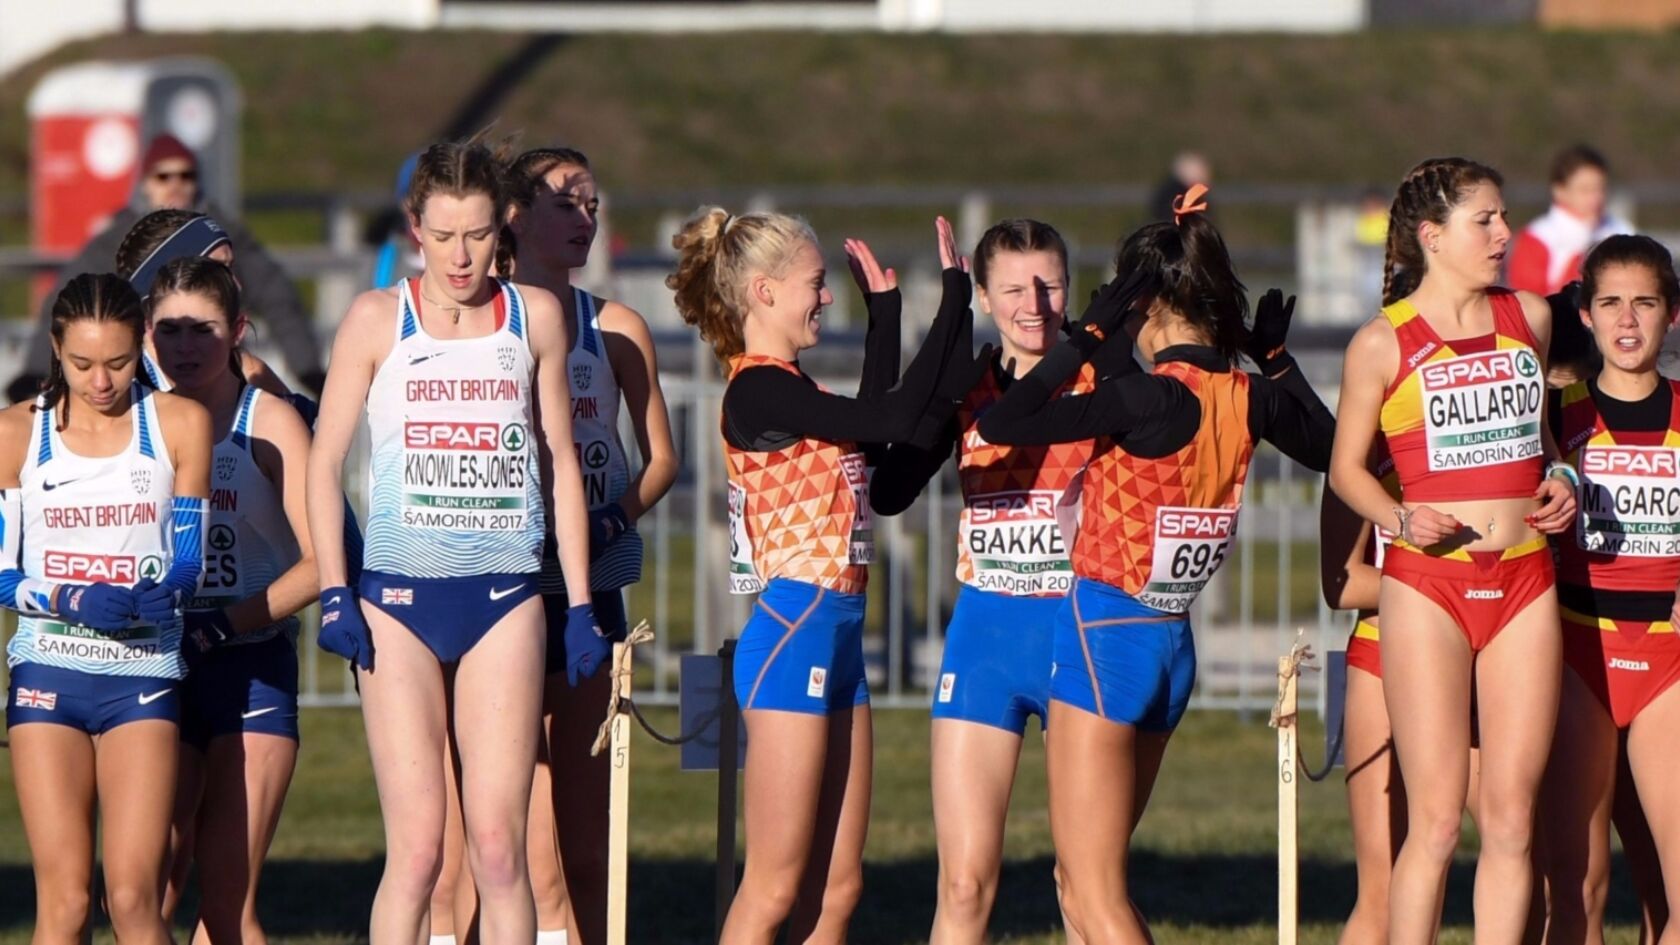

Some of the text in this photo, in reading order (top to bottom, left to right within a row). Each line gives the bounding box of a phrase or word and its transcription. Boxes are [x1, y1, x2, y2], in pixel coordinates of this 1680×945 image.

[1425, 357, 1512, 387] SPAR
[406, 379, 519, 402] GREAT BRITAIN
[571, 397, 599, 420] AIN
[1429, 381, 1540, 428] GALLARDO
[407, 425, 497, 448] SPAR
[1463, 434, 1486, 444] RUN
[1434, 443, 1513, 468] ŠAMORÍN
[1585, 451, 1674, 474] SPAR
[405, 453, 525, 489] KNOWLES-JONES
[210, 489, 238, 512] AIN
[435, 496, 458, 507] RUN
[973, 496, 1053, 520] SPAR
[1583, 483, 1680, 516] M. GARC
[43, 501, 156, 528] GREAT BRITAIN
[404, 508, 523, 529] ŠAMORÍN 2017
[1161, 514, 1231, 535] SPAR
[970, 524, 1065, 554] BAKKE
[47, 554, 133, 580] SPAR
[1171, 542, 1229, 579] 695
[70, 625, 94, 638] RUN
[38, 636, 157, 660] ŠAMORÍN 2017
